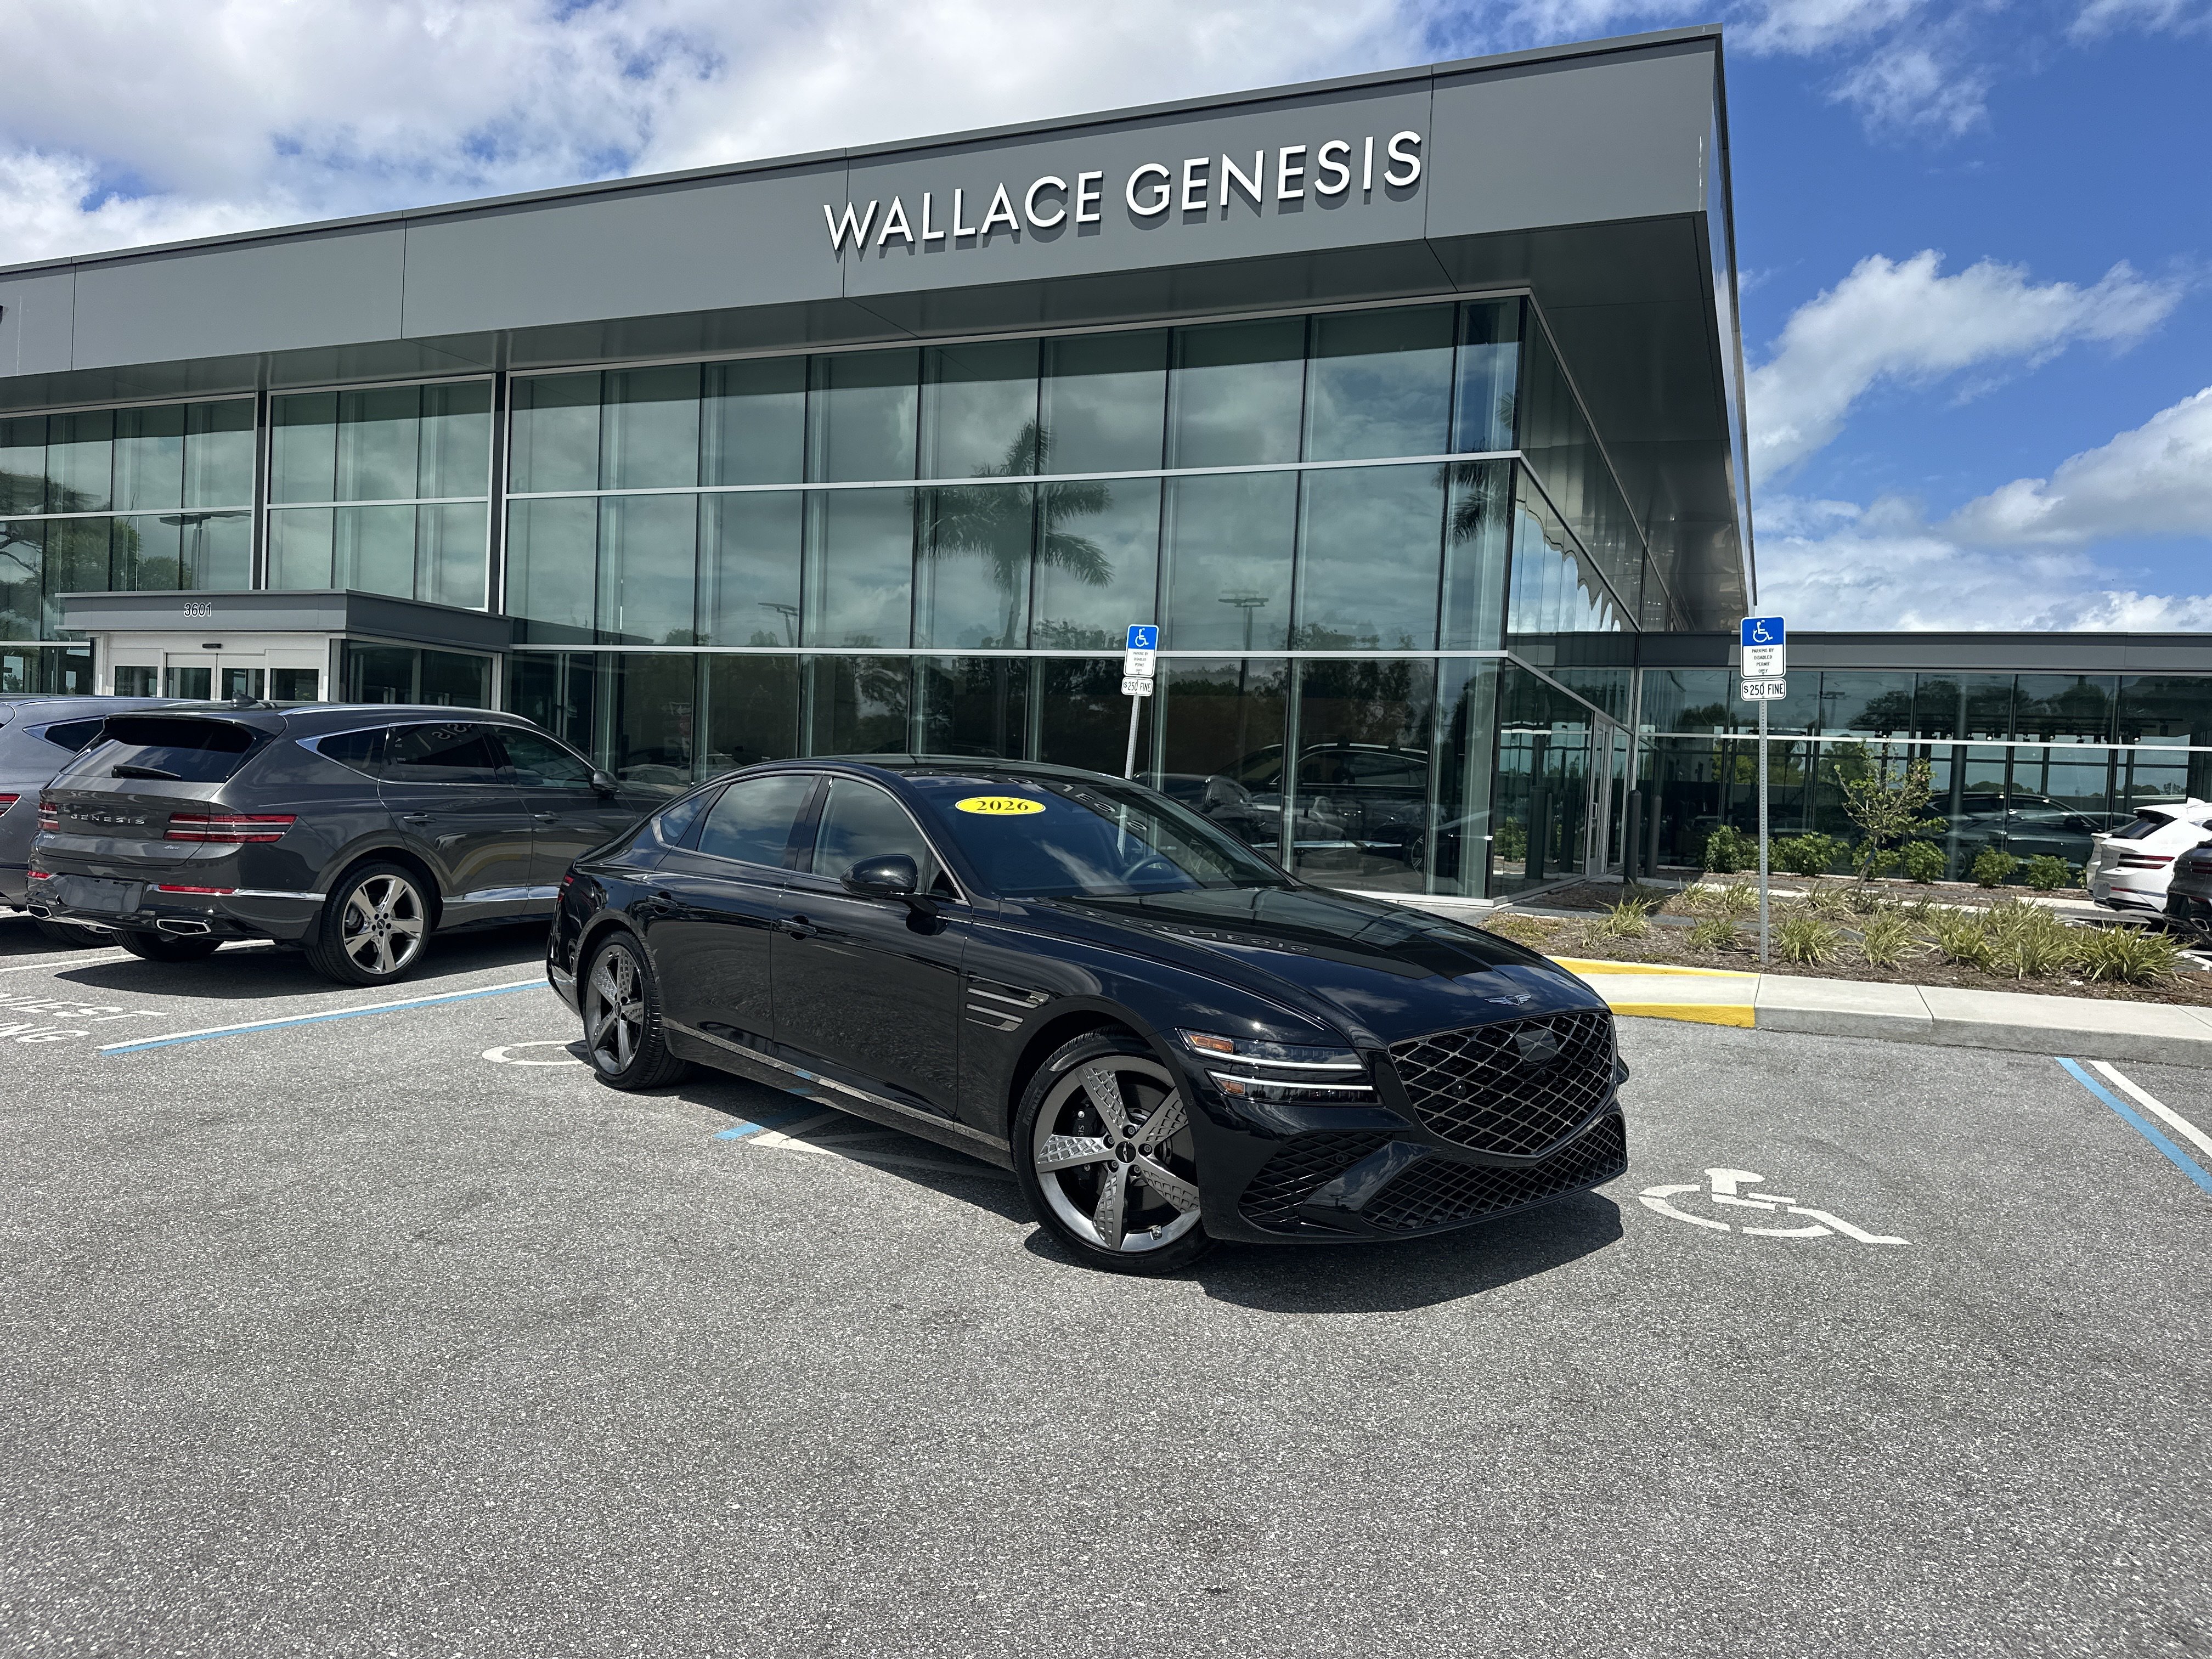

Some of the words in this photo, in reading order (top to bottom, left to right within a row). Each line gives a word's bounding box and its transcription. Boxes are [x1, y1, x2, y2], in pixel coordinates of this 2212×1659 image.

[823, 171, 1103, 251] WALLACE
[1126, 131, 1421, 216] GENESIS
[184, 602, 212, 617] 3601
[1124, 681, 1138, 691] $250
[1139, 682, 1151, 692] FINE
[1743, 684, 1764, 696] $250
[1768, 684, 1784, 695] FINE
[975, 800, 1029, 811] 2026
[70, 814, 145, 825] GENESIS
